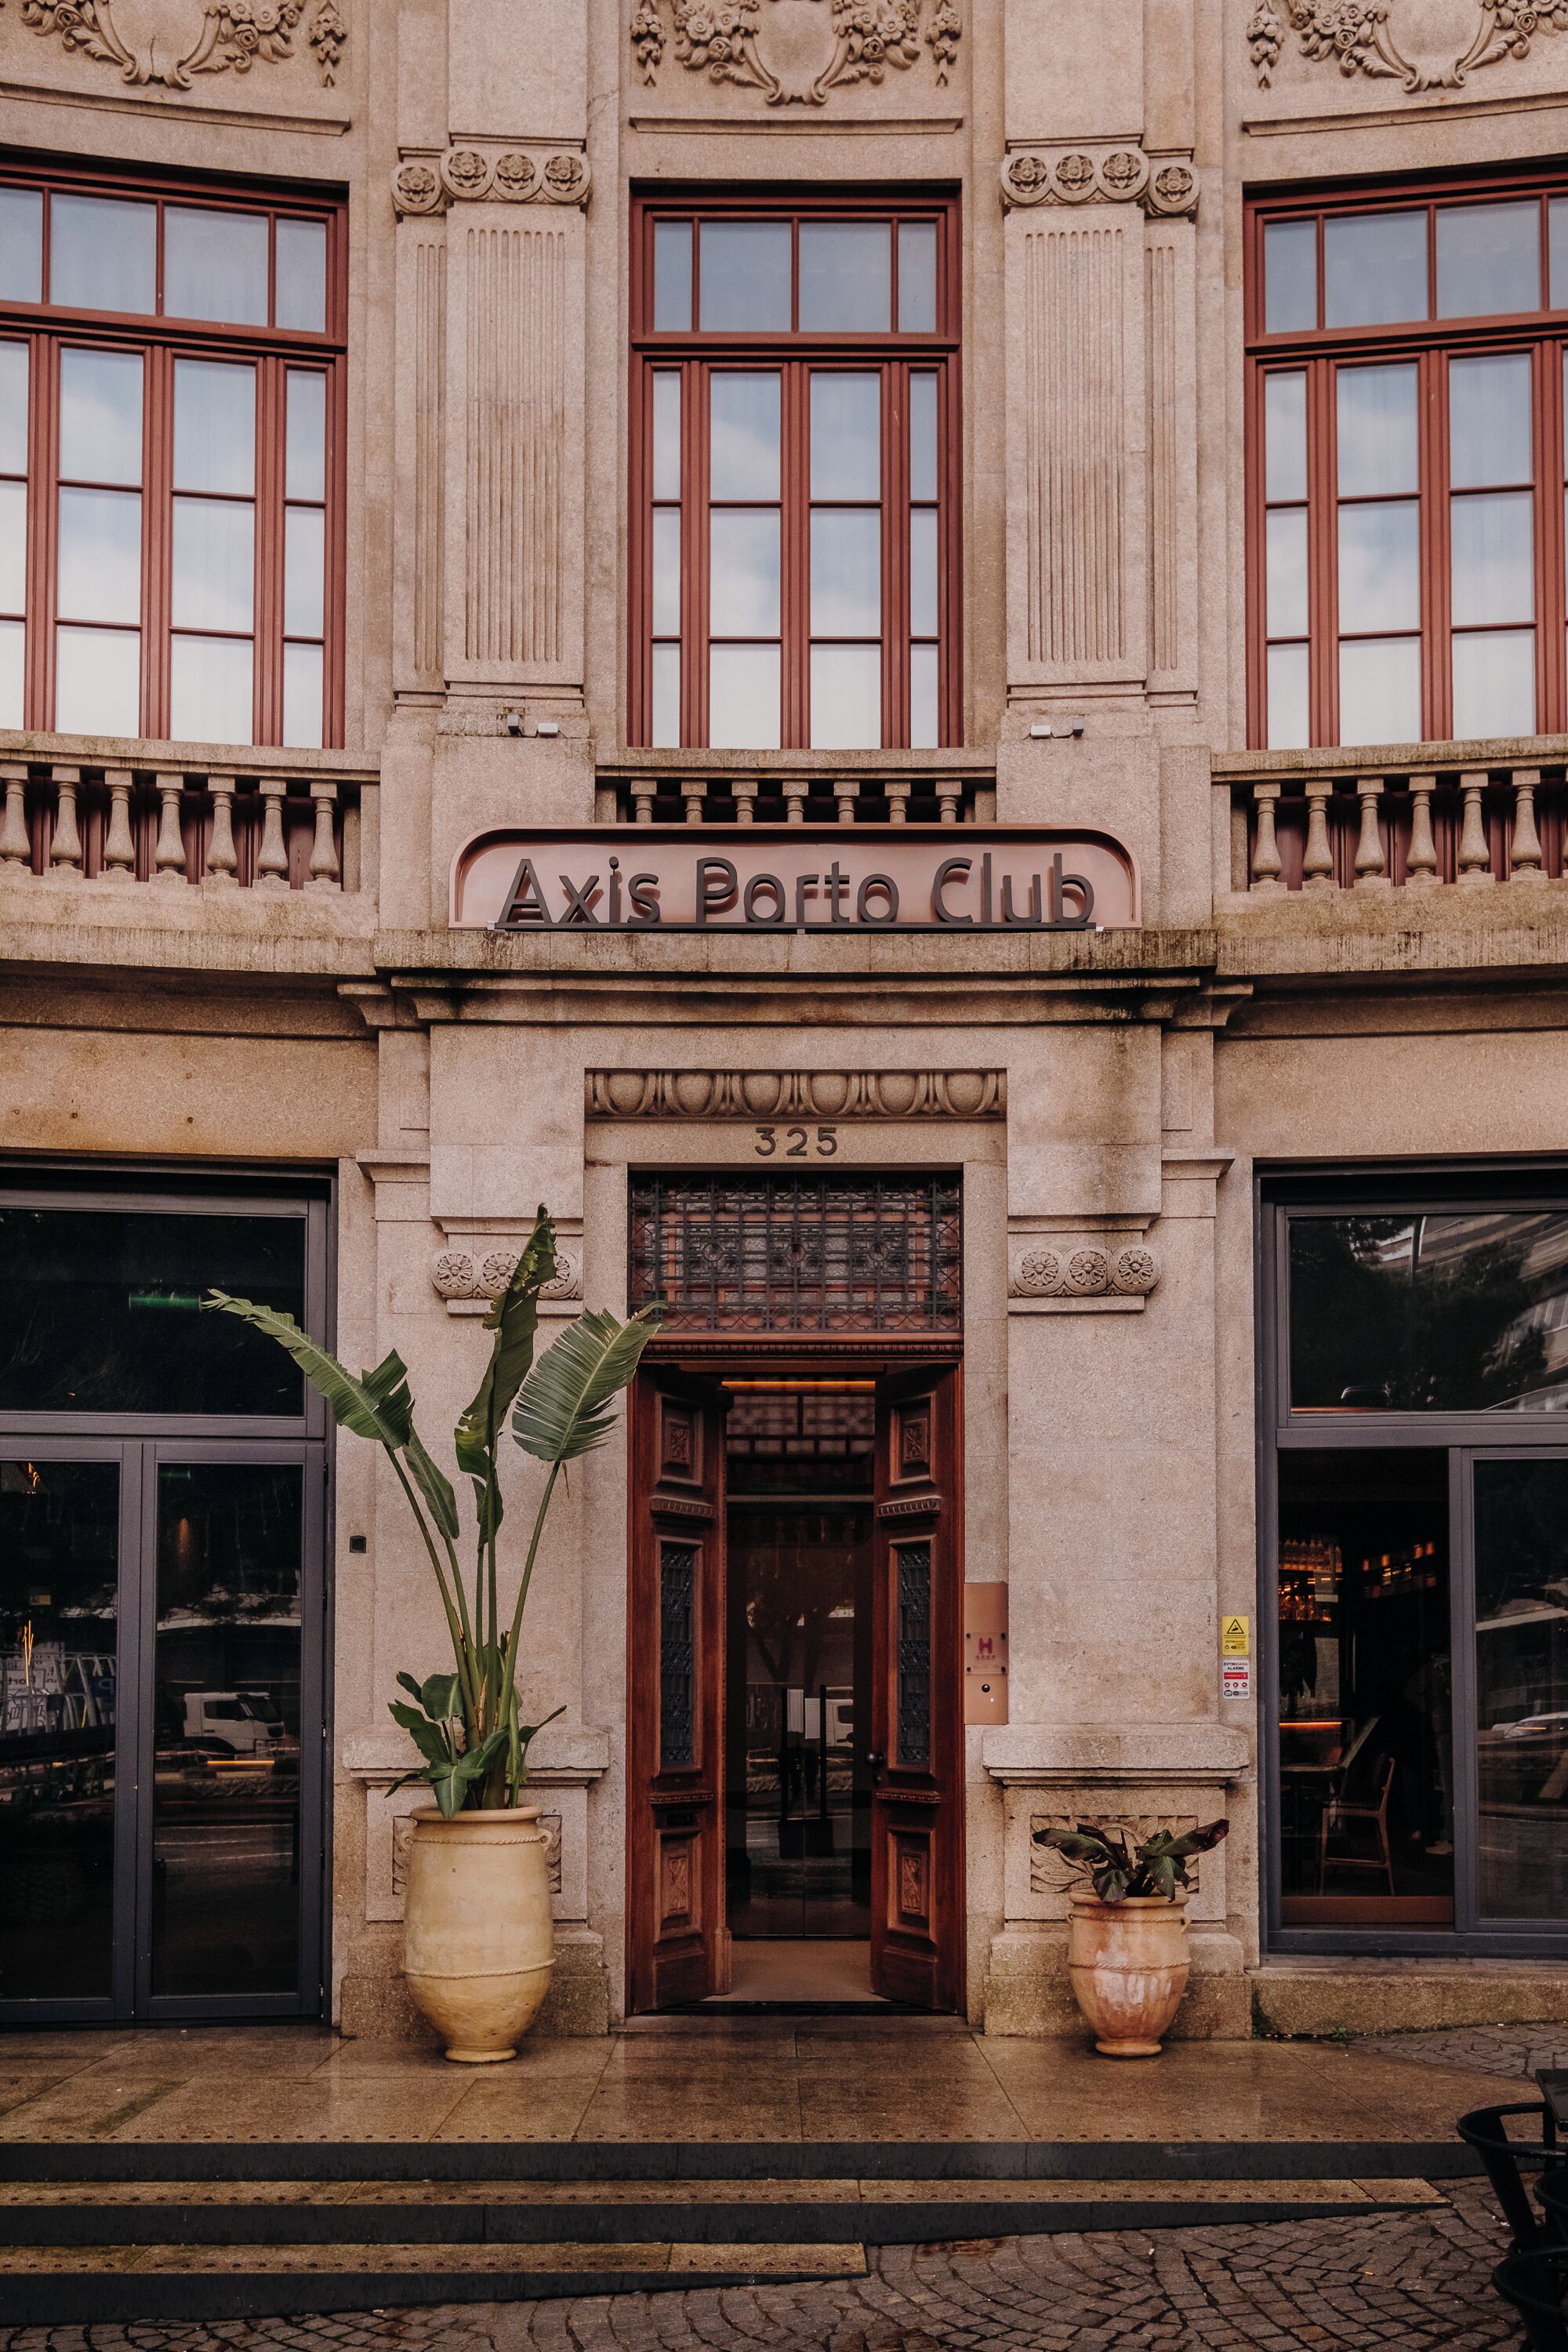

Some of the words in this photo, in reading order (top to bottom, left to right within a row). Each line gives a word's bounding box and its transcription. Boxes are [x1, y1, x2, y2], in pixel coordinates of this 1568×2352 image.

[497, 855, 660, 924] Axis
[695, 856, 900, 924] Porto
[932, 852, 1095, 924] Club
[754, 1127, 837, 1156] 325
[979, 1637, 993, 1654] H
